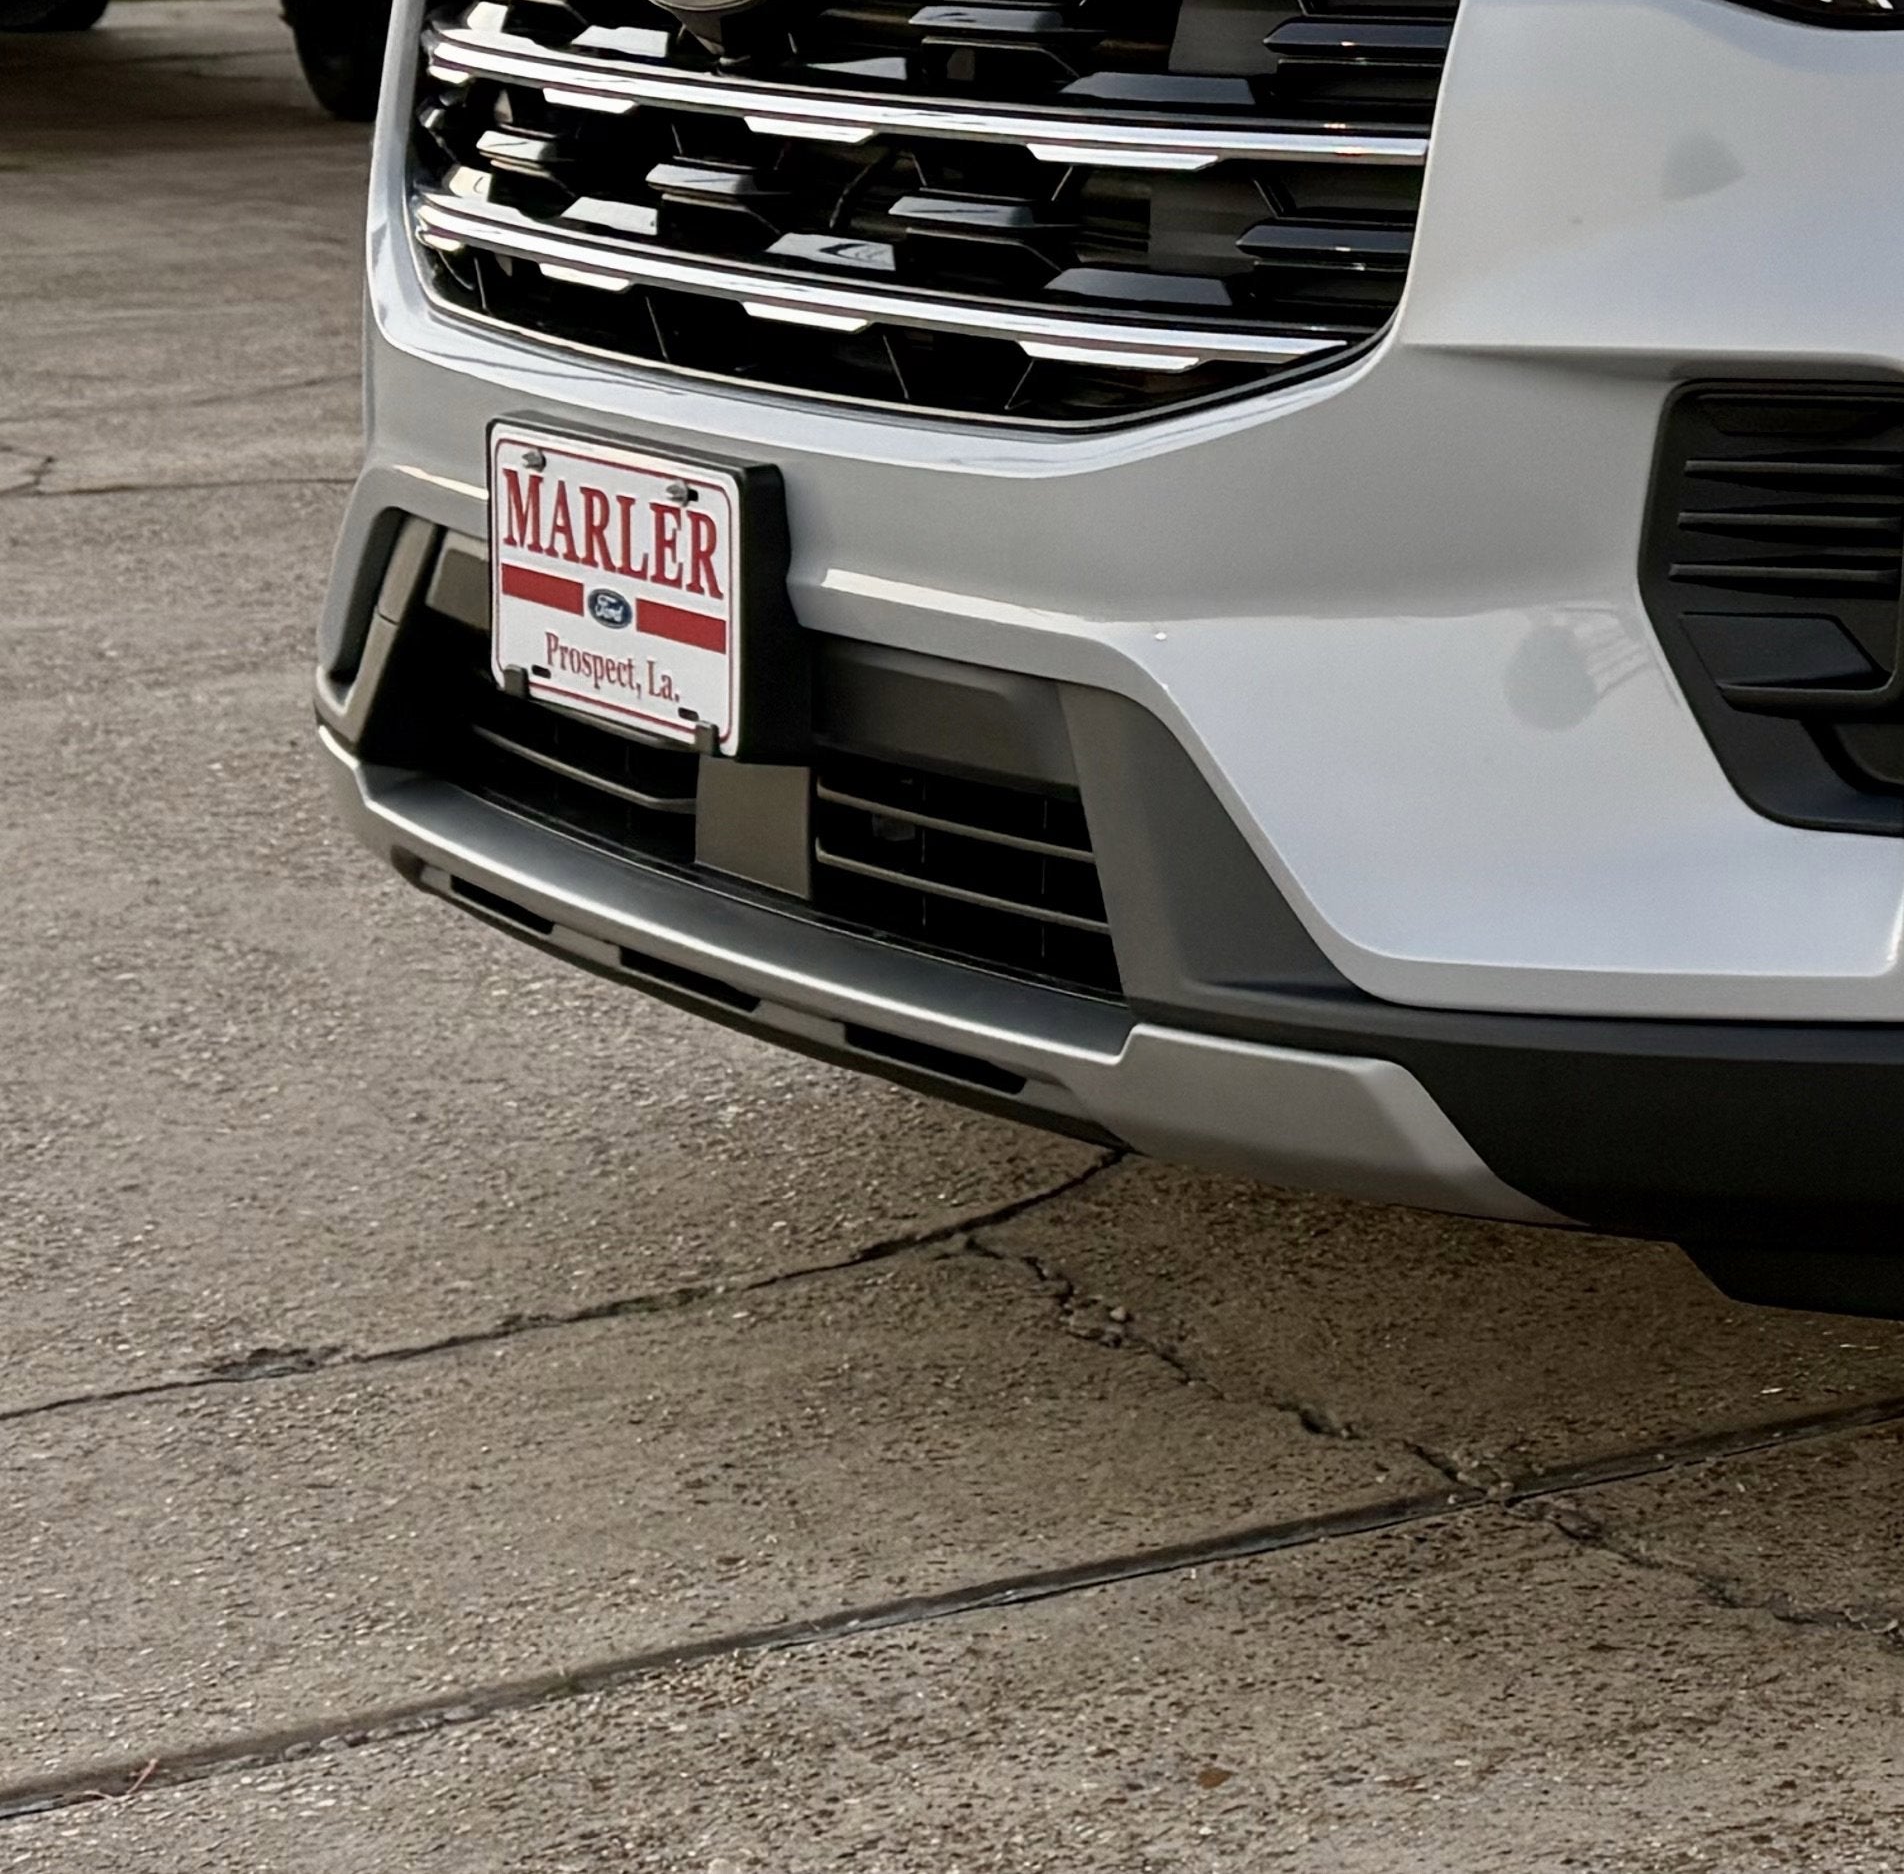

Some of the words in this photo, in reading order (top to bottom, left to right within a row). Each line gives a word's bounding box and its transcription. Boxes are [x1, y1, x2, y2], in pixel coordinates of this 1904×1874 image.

[502, 468, 724, 600] MARLER
[545, 632, 641, 700] Prospect,
[646, 660, 680, 703] La.
